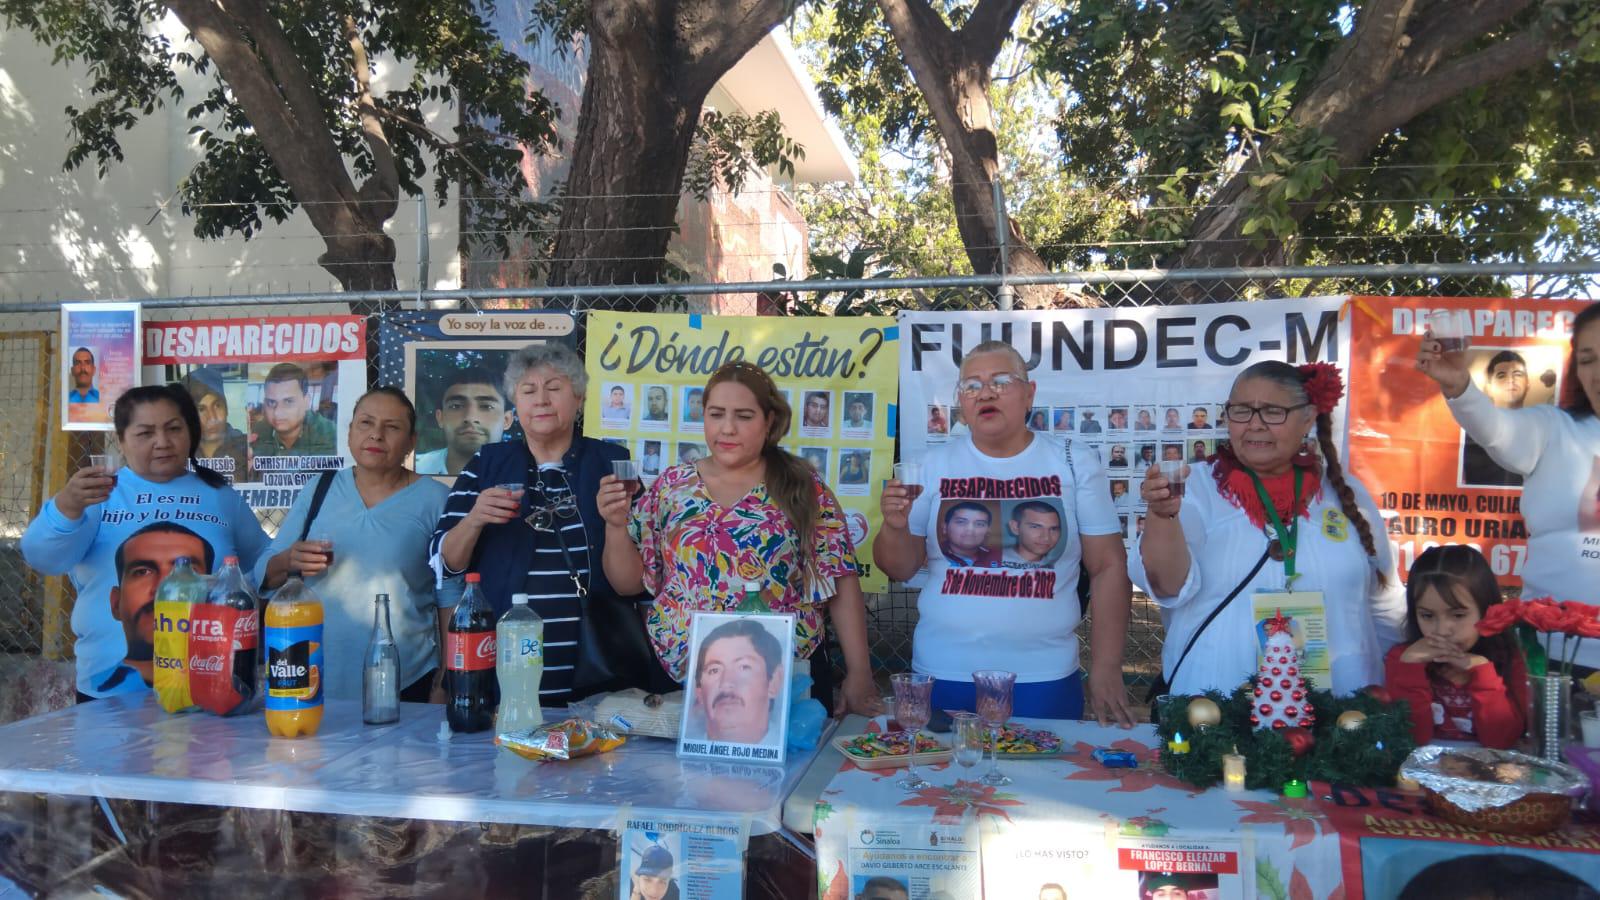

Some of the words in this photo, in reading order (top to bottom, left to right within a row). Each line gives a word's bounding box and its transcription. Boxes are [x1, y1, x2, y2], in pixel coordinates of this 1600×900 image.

[447, 318, 461, 330] Yo
[465, 321, 486, 332] soy
[490, 318, 500, 330] la
[504, 321, 526, 330] voz
[146, 322, 359, 358] DESAPARECIDOS
[911, 311, 1339, 371] FUUNDEC-M
[600, 321, 745, 374] ¿Dónde
[757, 327, 884, 379] están?
[254, 457, 299, 470] CHRISTIAN
[301, 457, 345, 469] GEOVANNY
[264, 473, 293, 486] LOZOYA
[940, 475, 1062, 499] DESAPARECIDOS
[136, 493, 153, 505] El
[157, 495, 175, 504] es
[180, 495, 201, 505] mi
[1402, 493, 1421, 510] DE
[1425, 494, 1472, 514] MAYO,
[101, 509, 134, 525] hijo
[137, 512, 149, 523] y
[154, 509, 170, 520] lo
[961, 569, 1019, 598] Noviembre
[1019, 571, 1033, 598] de
[277, 659, 288, 667] del
[271, 664, 307, 678] Valle
[683, 742, 708, 754] MIGUEL
[709, 741, 730, 756] ÁNGEL
[732, 746, 751, 758] ROJO
[752, 747, 779, 760] MEDINA
[627, 820, 655, 831] RAFAEL
[1130, 849, 1184, 861] FRANCISCO
[1187, 851, 1227, 863] ELEAZAR
[1175, 861, 1212, 872] BERNAL
